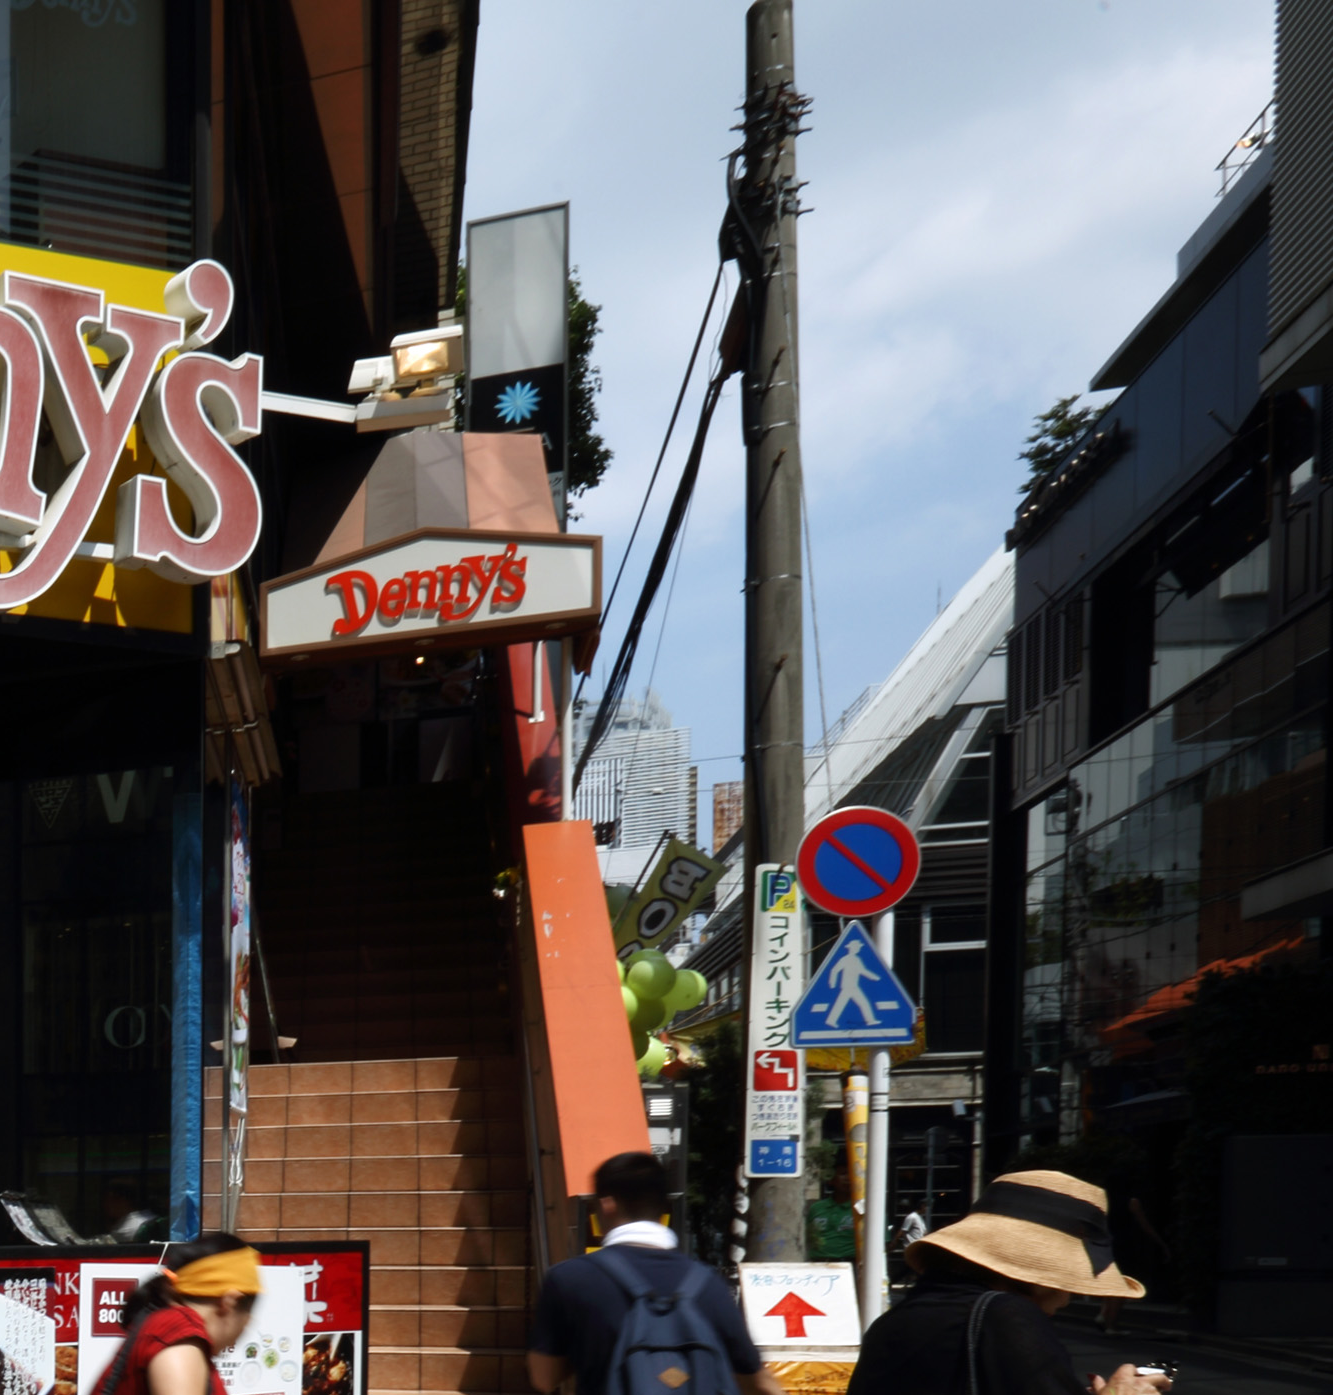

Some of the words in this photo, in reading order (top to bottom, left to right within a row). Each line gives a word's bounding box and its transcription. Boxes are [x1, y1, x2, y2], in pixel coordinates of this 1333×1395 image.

[331, 541, 528, 637] Denny's
[763, 915, 792, 1048] コインパーキング
